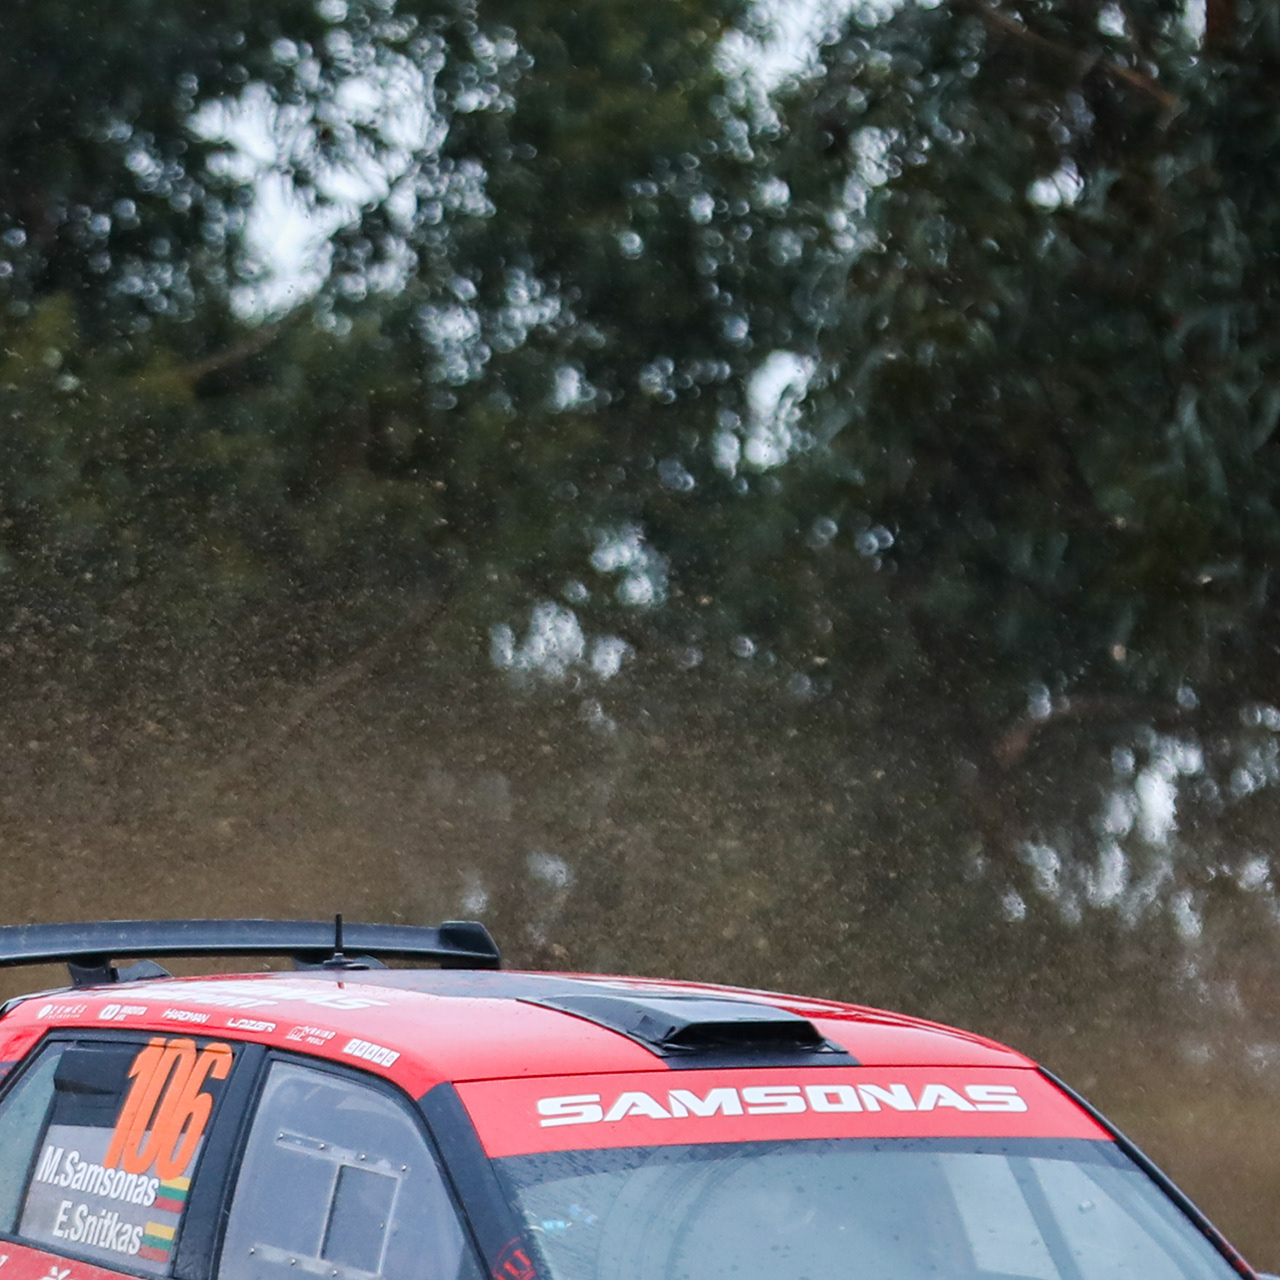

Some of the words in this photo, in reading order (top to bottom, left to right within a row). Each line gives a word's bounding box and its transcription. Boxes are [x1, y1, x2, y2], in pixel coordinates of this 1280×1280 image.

[103, 1037, 234, 1181] 106
[537, 1084, 1029, 1127] SAMSONAS
[37, 1146, 160, 1207] M.Samsonas
[52, 1200, 144, 1255] E.Snitkas
